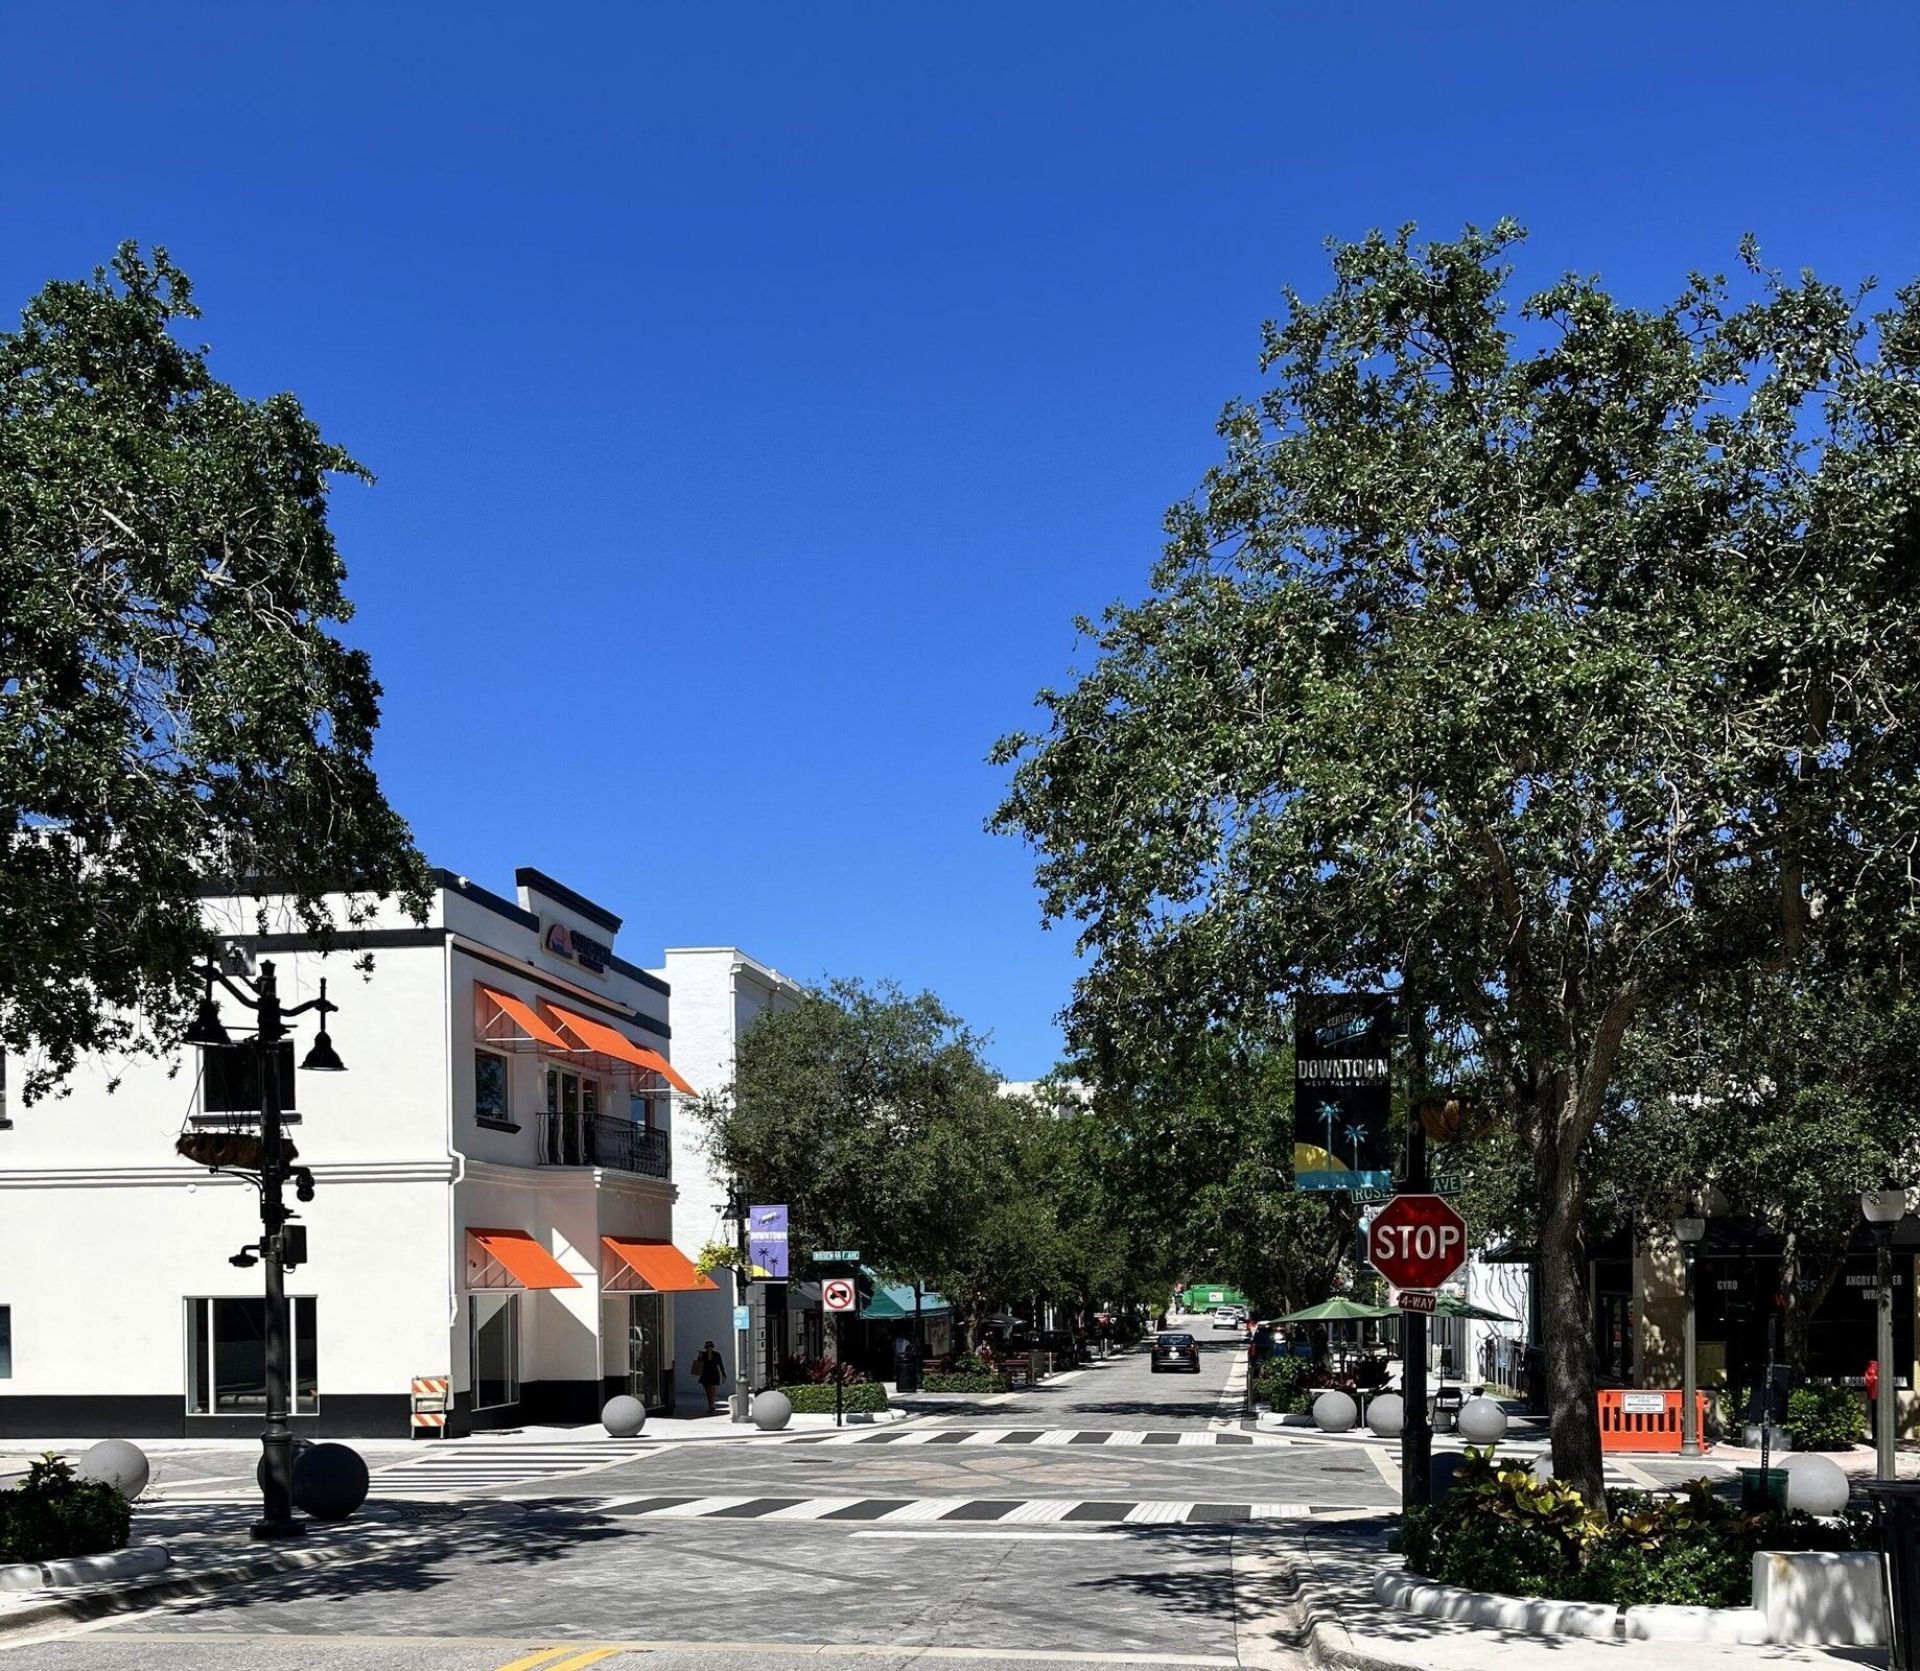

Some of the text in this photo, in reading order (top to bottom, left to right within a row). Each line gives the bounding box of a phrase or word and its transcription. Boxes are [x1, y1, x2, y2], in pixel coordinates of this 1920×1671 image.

[1298, 1059, 1388, 1079] DOWNTOWN
[1433, 1177, 1458, 1192] AVE
[1375, 1225, 1460, 1260] STOP
[1716, 1280, 1738, 1290] GYRO
[1846, 1275, 1871, 1286] ANGRY
[1401, 1295, 1434, 1310] 4-WAY
